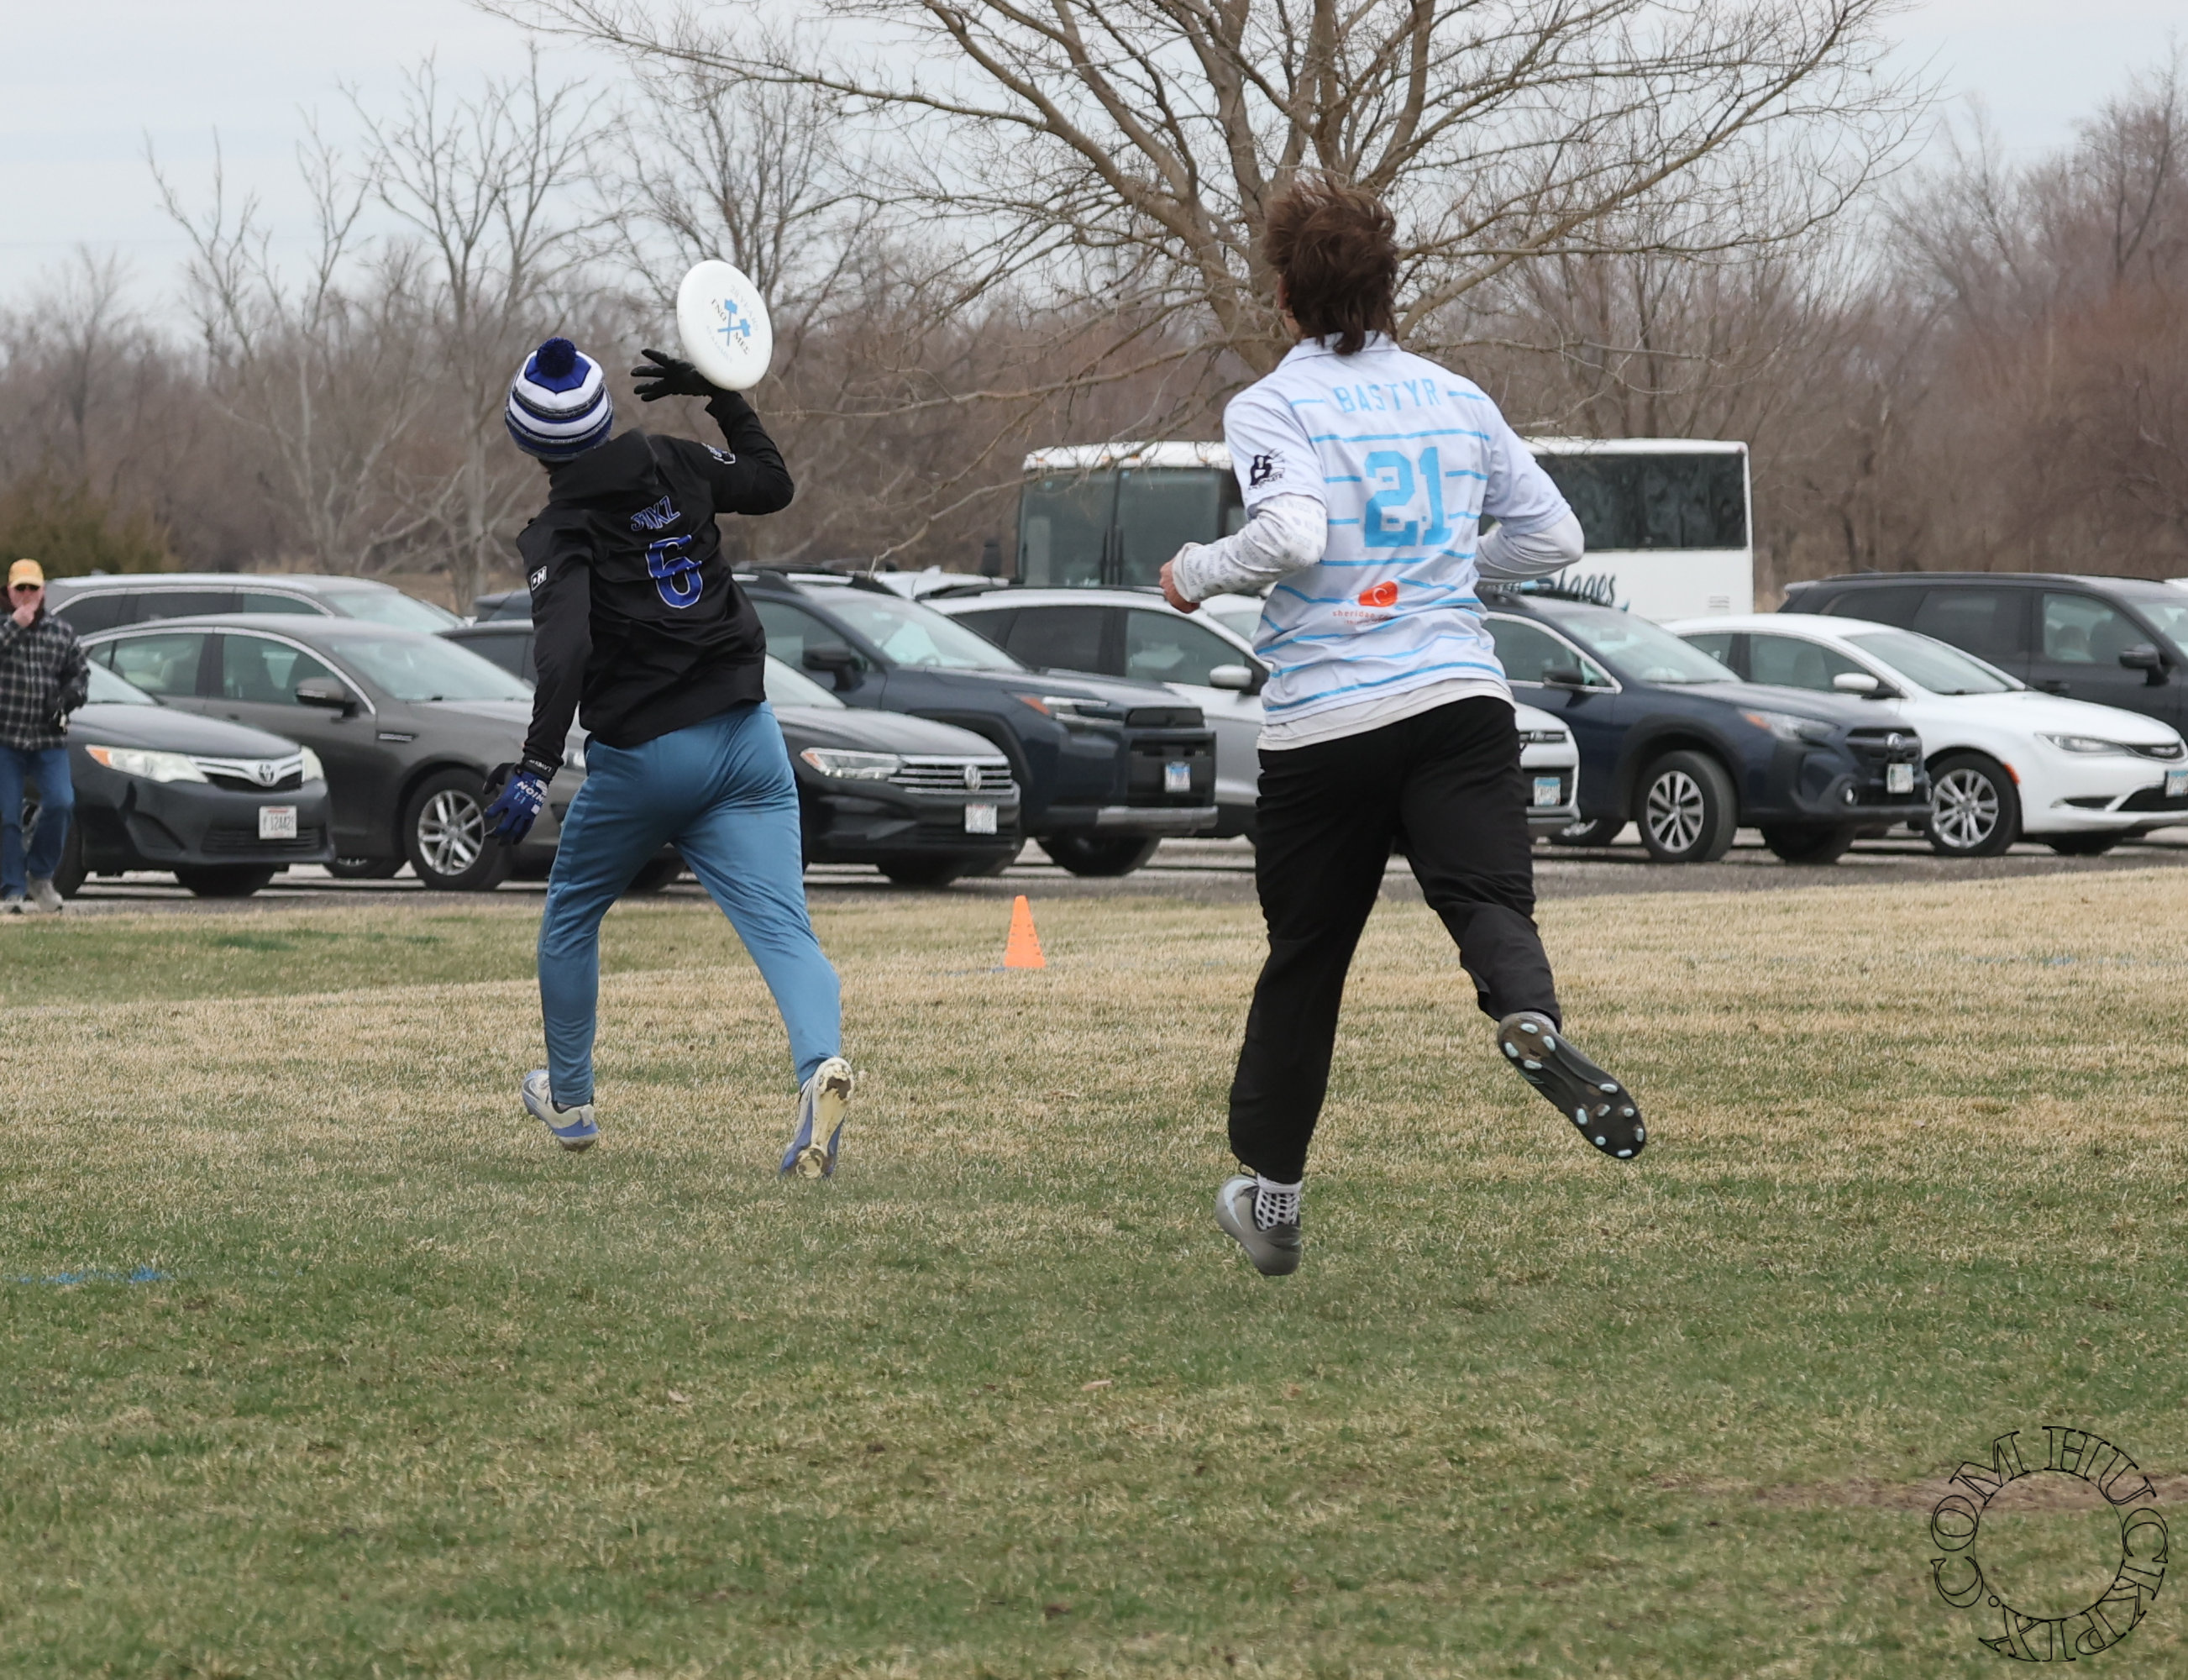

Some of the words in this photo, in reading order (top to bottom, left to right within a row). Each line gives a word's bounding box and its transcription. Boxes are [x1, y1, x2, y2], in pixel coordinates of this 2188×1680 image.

[1333, 377, 1441, 412] BASTYR
[1364, 447, 1452, 548] 21
[645, 534, 704, 609] 6
